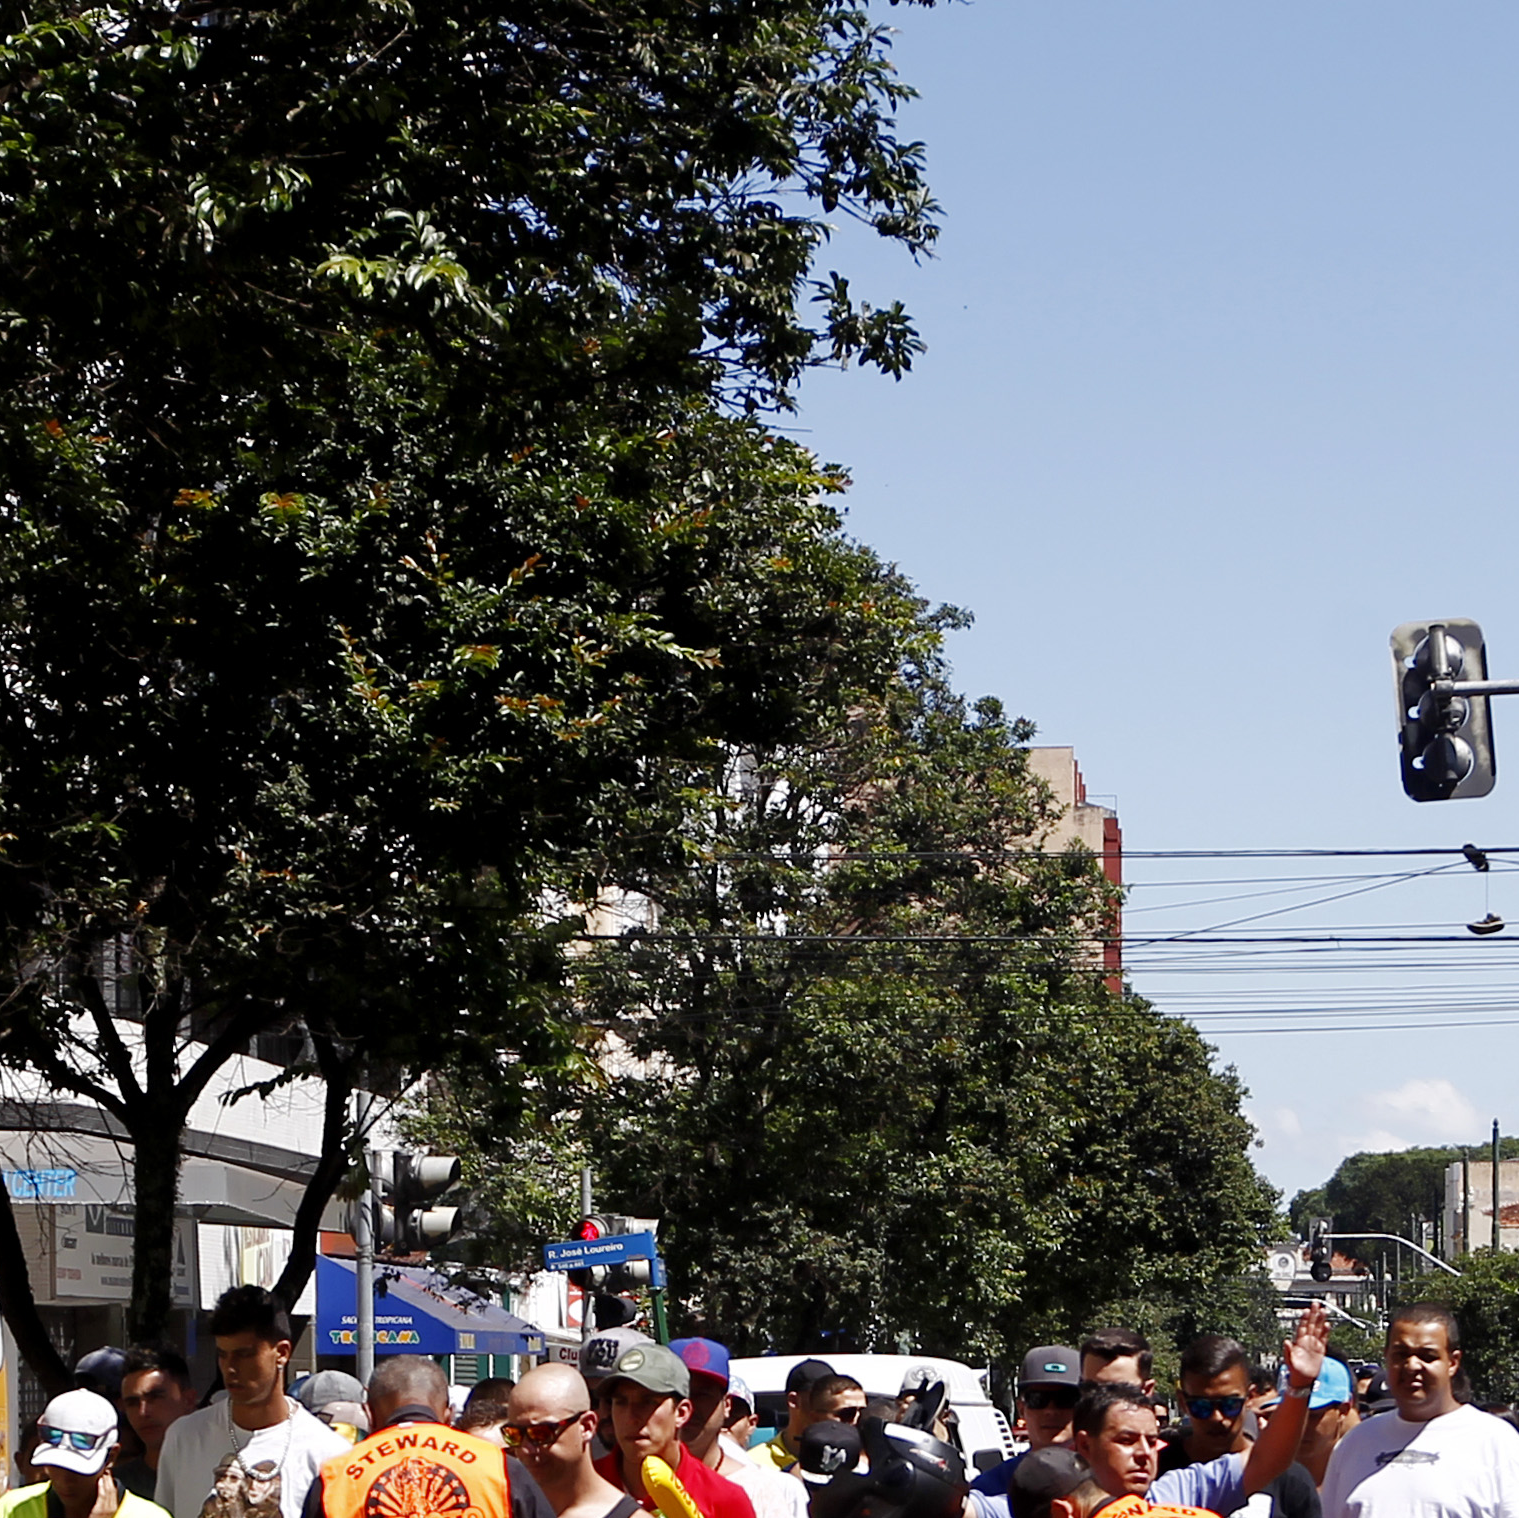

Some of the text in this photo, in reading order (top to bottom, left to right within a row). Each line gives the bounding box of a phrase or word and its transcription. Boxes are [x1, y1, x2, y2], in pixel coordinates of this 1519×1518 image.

[12, 1169, 77, 1197] CENTER
[548, 1242, 624, 1259] R. José Loureiro
[329, 1330, 420, 1344] TROICANA
[346, 1434, 478, 1480] STEWARD
